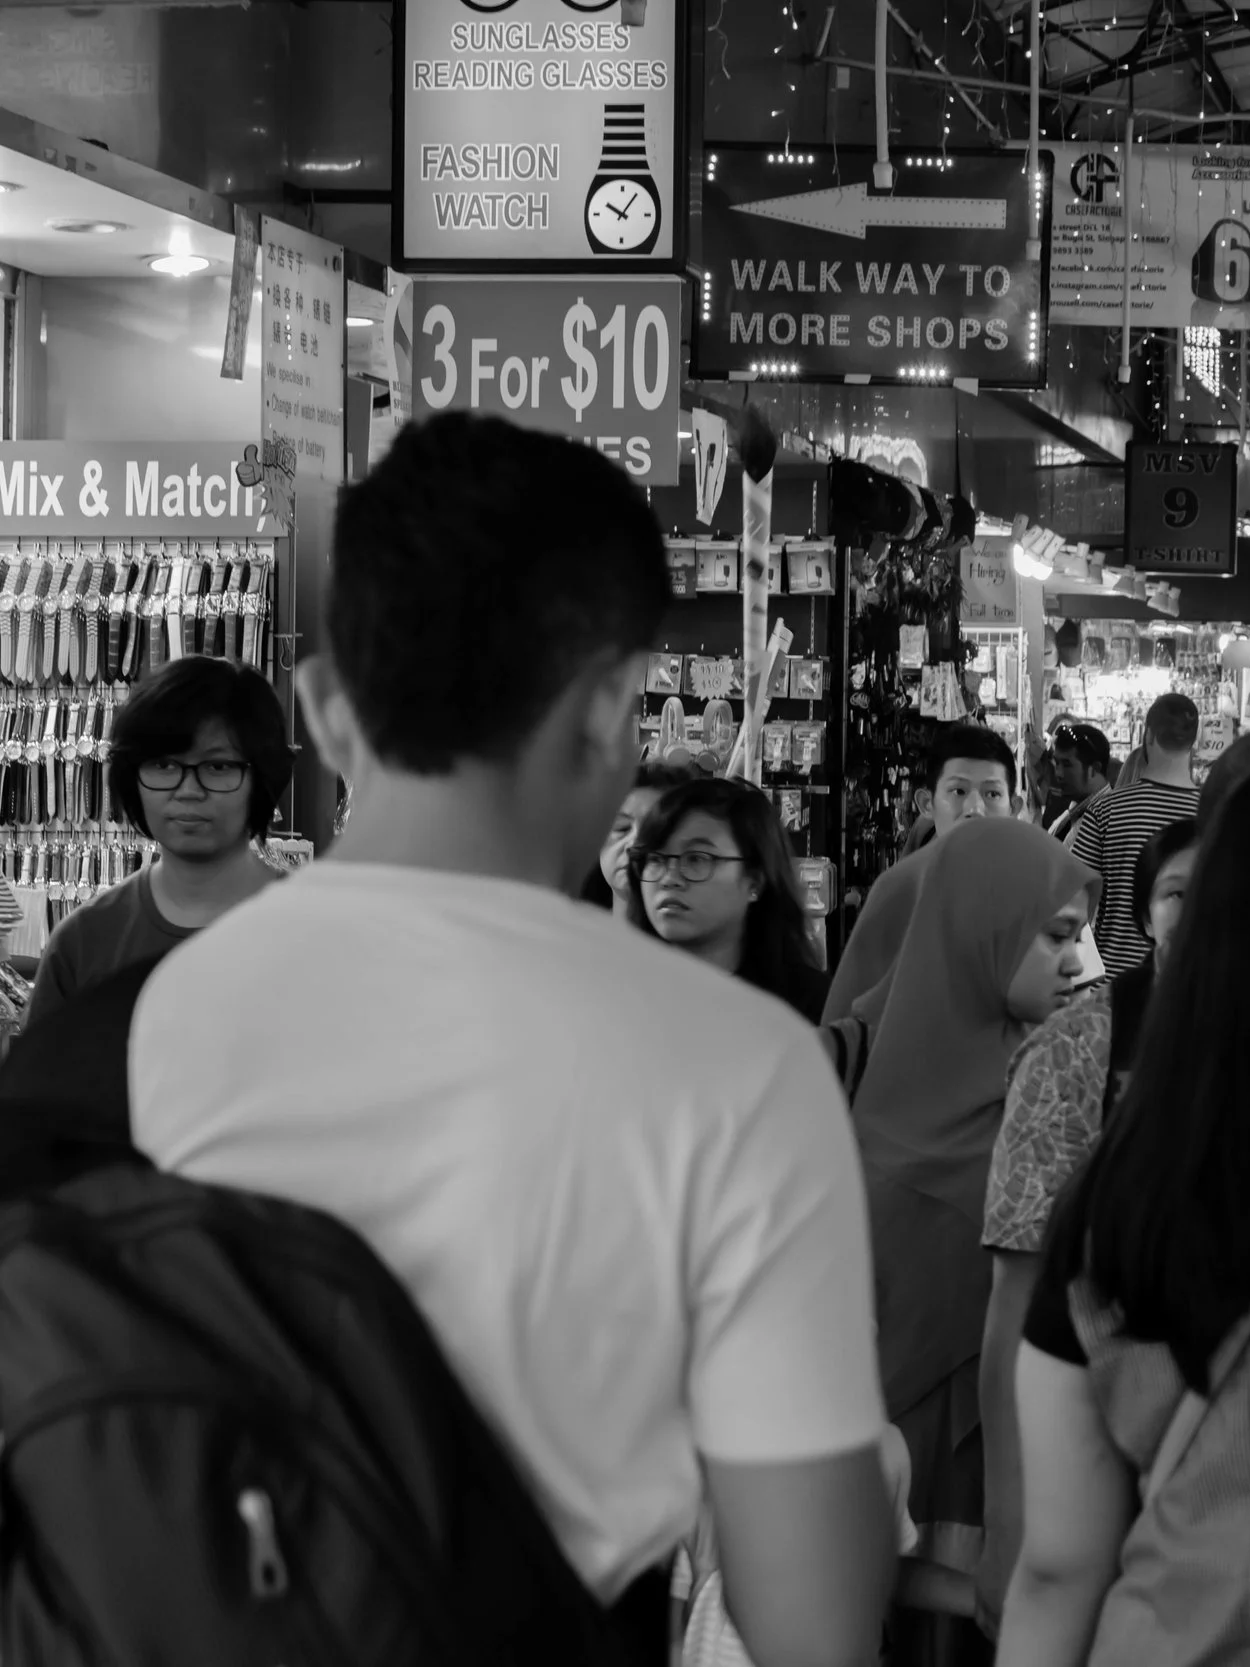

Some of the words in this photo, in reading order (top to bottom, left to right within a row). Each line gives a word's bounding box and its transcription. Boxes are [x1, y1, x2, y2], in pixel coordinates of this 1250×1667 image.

[452, 22, 630, 51] SUNGLASSES
[413, 61, 535, 90] READING
[541, 61, 668, 90] GLASSES
[421, 144, 560, 181] FASHION
[433, 192, 549, 229] WATCH
[731, 259, 842, 293] WALK
[855, 261, 945, 296] WAY
[959, 264, 1011, 298] TO
[729, 312, 851, 346] MORE
[867, 315, 1009, 352] SHOPS
[421, 304, 457, 410] 3
[470, 338, 550, 410] For
[560, 296, 669, 423] $10
[1143, 452, 1221, 474] MSV
[0, 460, 64, 517] Mix
[79, 460, 110, 517] &
[1163, 487, 1199, 529] 9
[969, 562, 1006, 585] Hiring
[1137, 547, 1223, 564] T-SHIRT
[970, 603, 986, 617] Full
